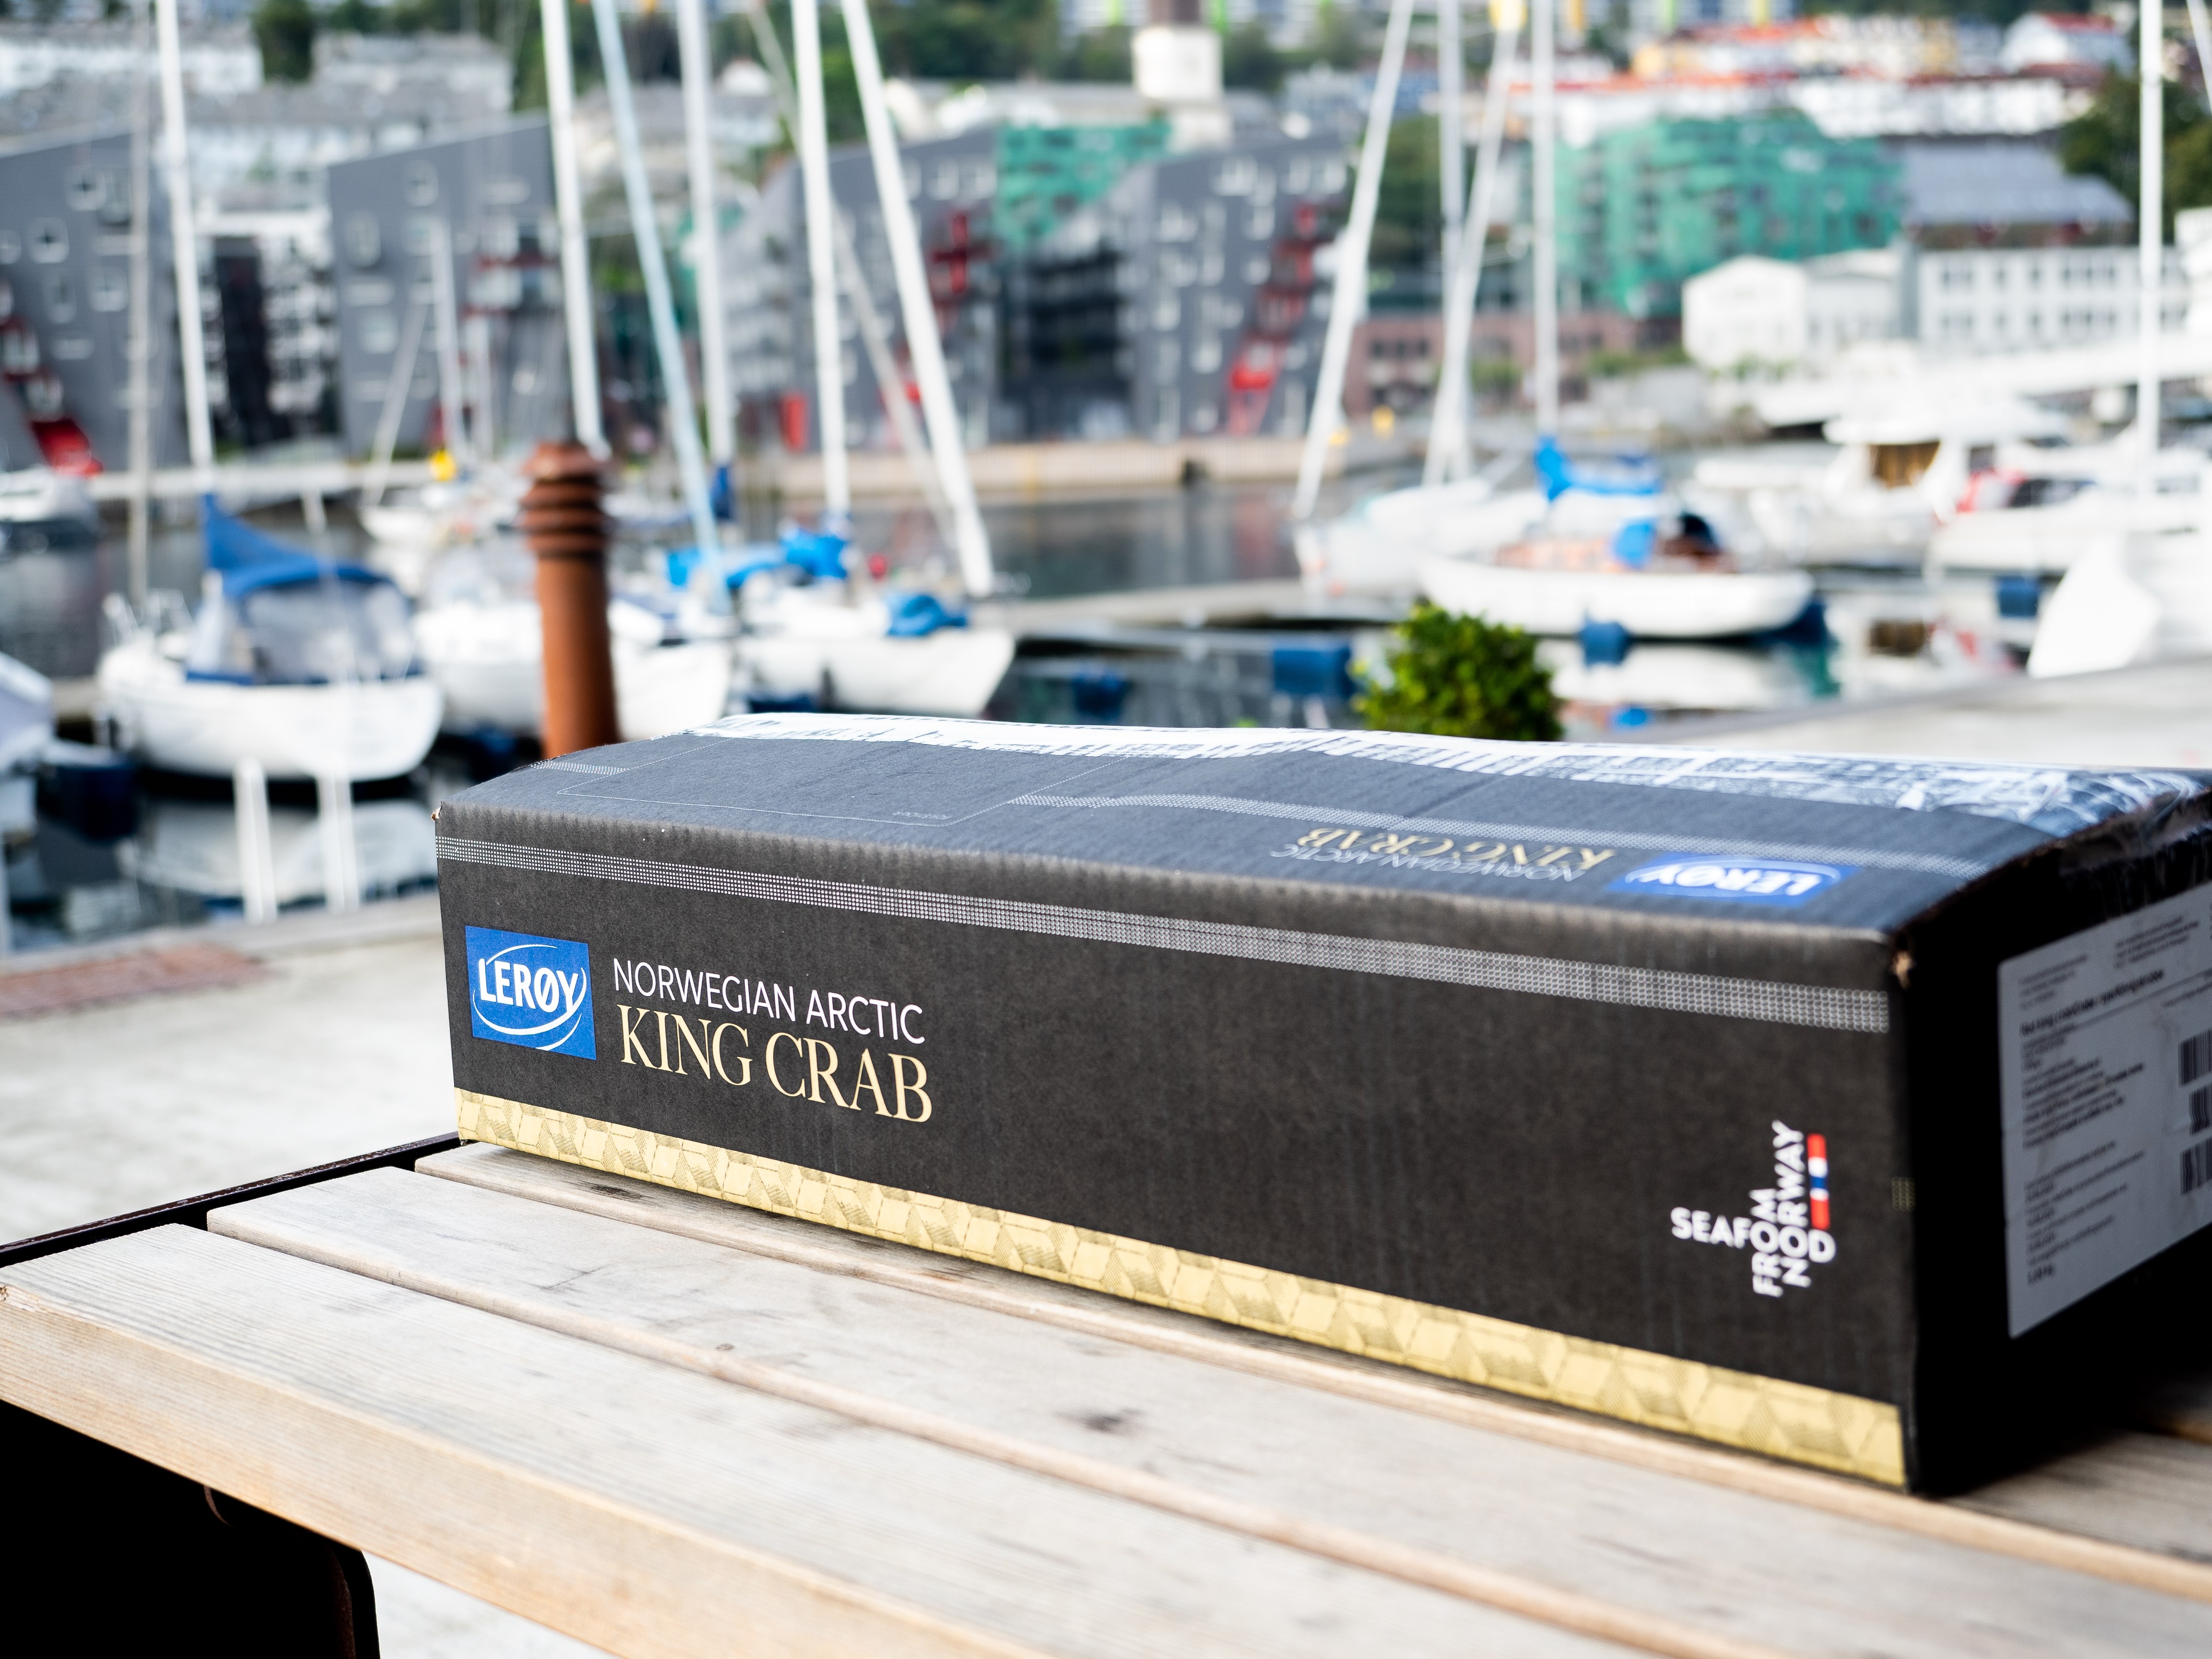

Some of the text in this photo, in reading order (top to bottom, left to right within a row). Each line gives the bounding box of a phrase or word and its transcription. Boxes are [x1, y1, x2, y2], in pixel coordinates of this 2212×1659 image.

[1270, 843, 1587, 882] NORWEGIAN ARCTIC
[1296, 828, 1617, 870] KING CRAB
[1637, 865, 1822, 896] LERØY
[478, 958, 578, 1014] LERØY
[613, 958, 926, 1045] NORWEGIAN ARCTIC
[617, 1004, 933, 1123] KING CRAB
[1772, 1119, 1812, 1288] NORWAY
[1671, 1207, 1837, 1263] SEAFOOD
[1749, 1188, 1784, 1297] FROM
